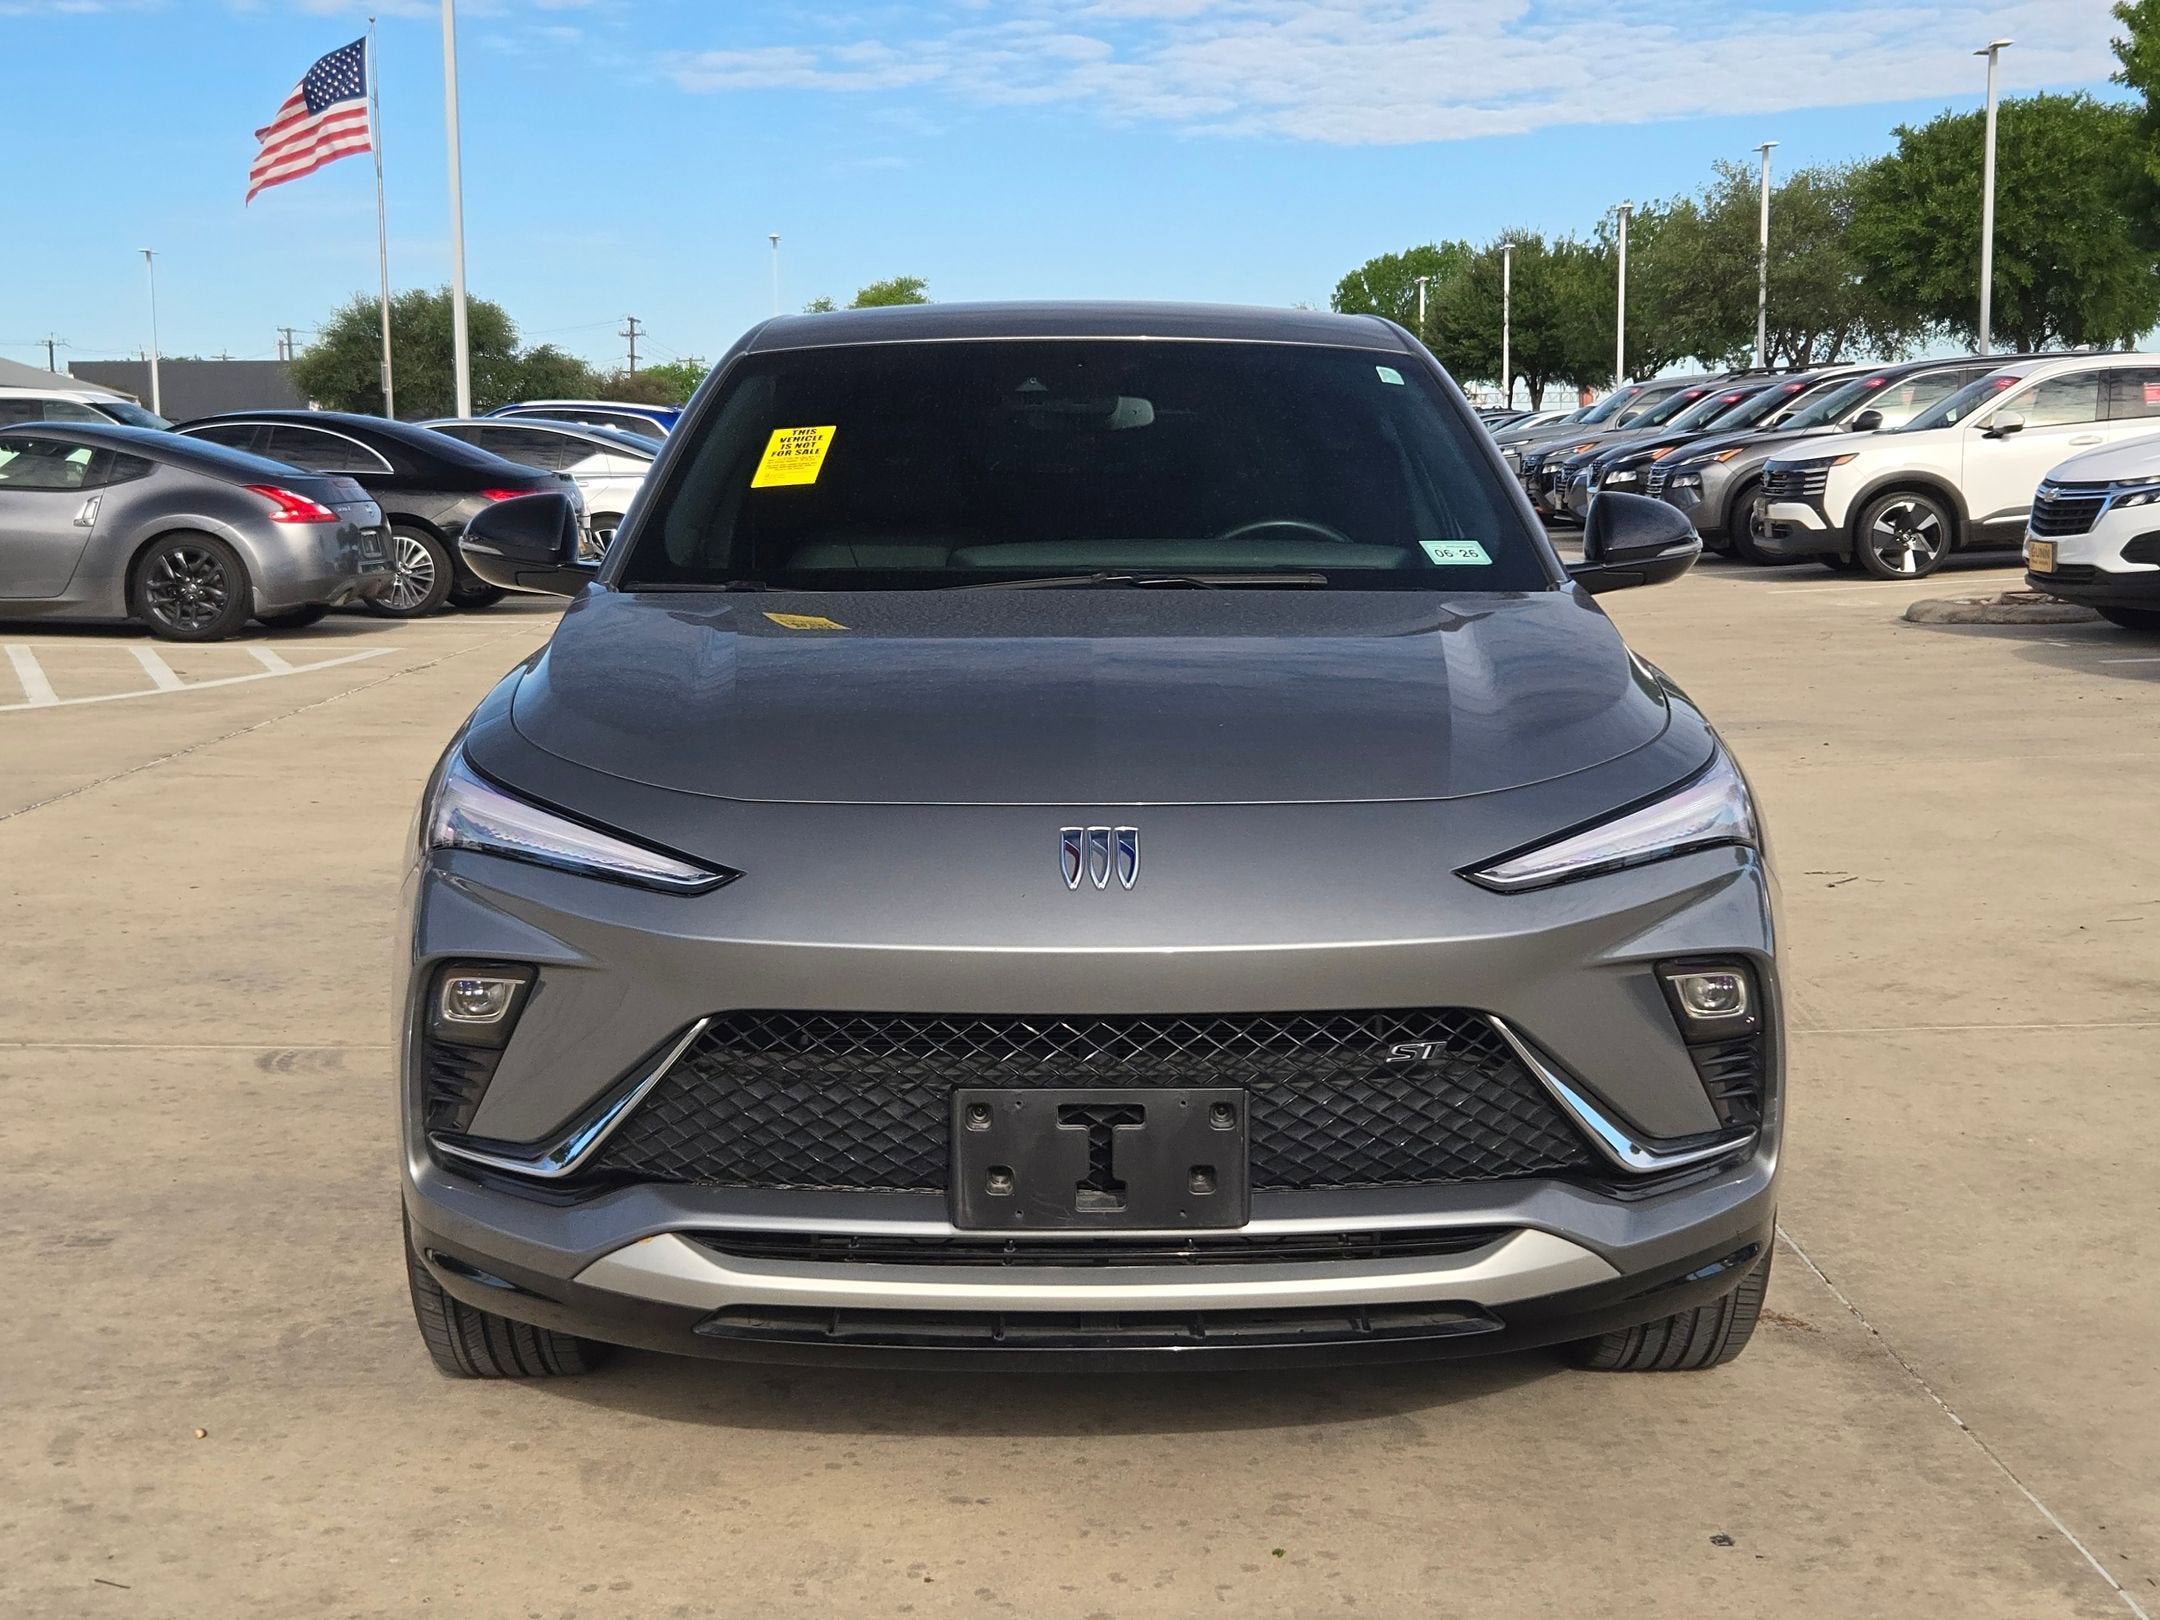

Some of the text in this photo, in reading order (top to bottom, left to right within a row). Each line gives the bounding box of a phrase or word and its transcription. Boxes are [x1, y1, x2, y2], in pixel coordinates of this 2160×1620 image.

[780, 435, 824, 443] VEHICLE
[795, 448, 821, 456] SALE
[1385, 1040, 1447, 1063] ST
